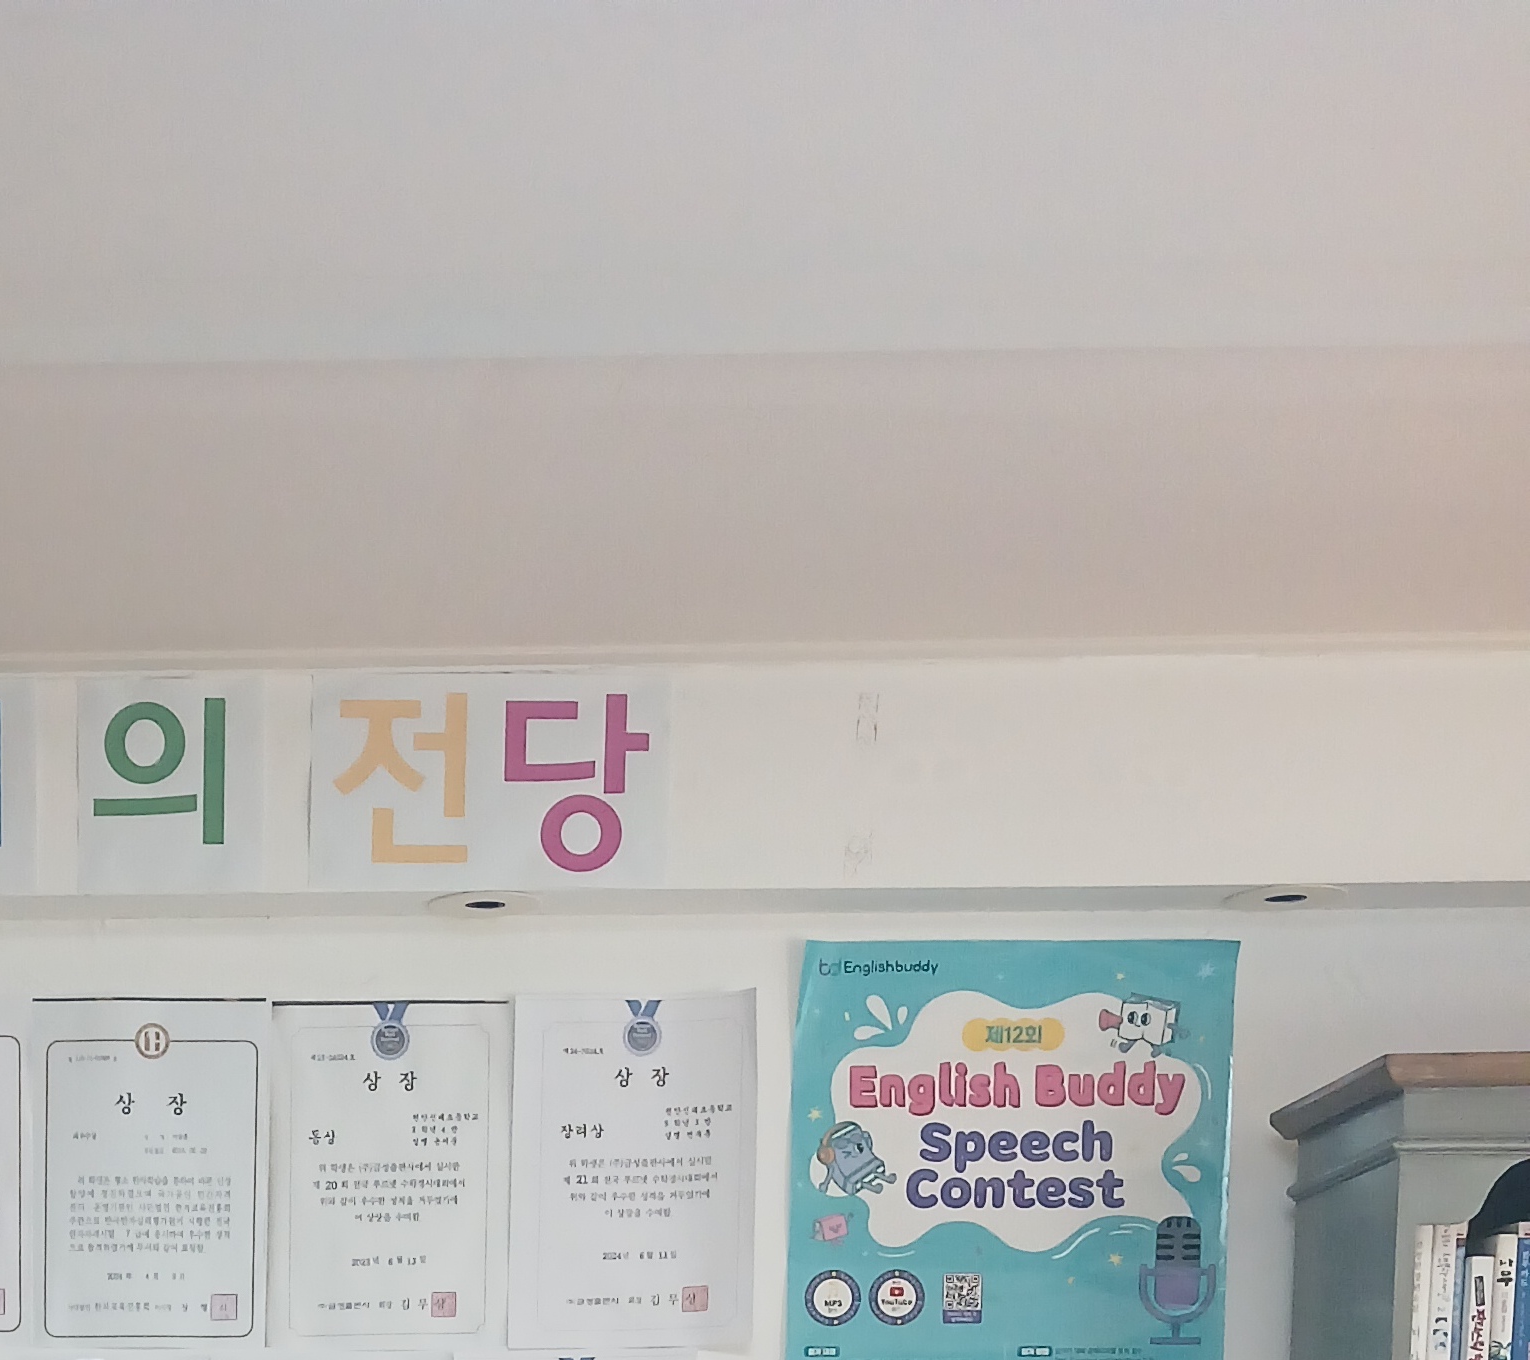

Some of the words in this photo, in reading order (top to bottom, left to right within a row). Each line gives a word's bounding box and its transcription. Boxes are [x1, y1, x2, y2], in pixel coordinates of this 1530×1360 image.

[333, 691, 650, 873] 전당
[843, 958, 939, 976] Englishbuddy
[848, 1061, 1021, 1116] English
[1035, 1060, 1186, 1115] Buddy
[919, 1119, 1113, 1173] Speech
[905, 1169, 1126, 1209] Contest
